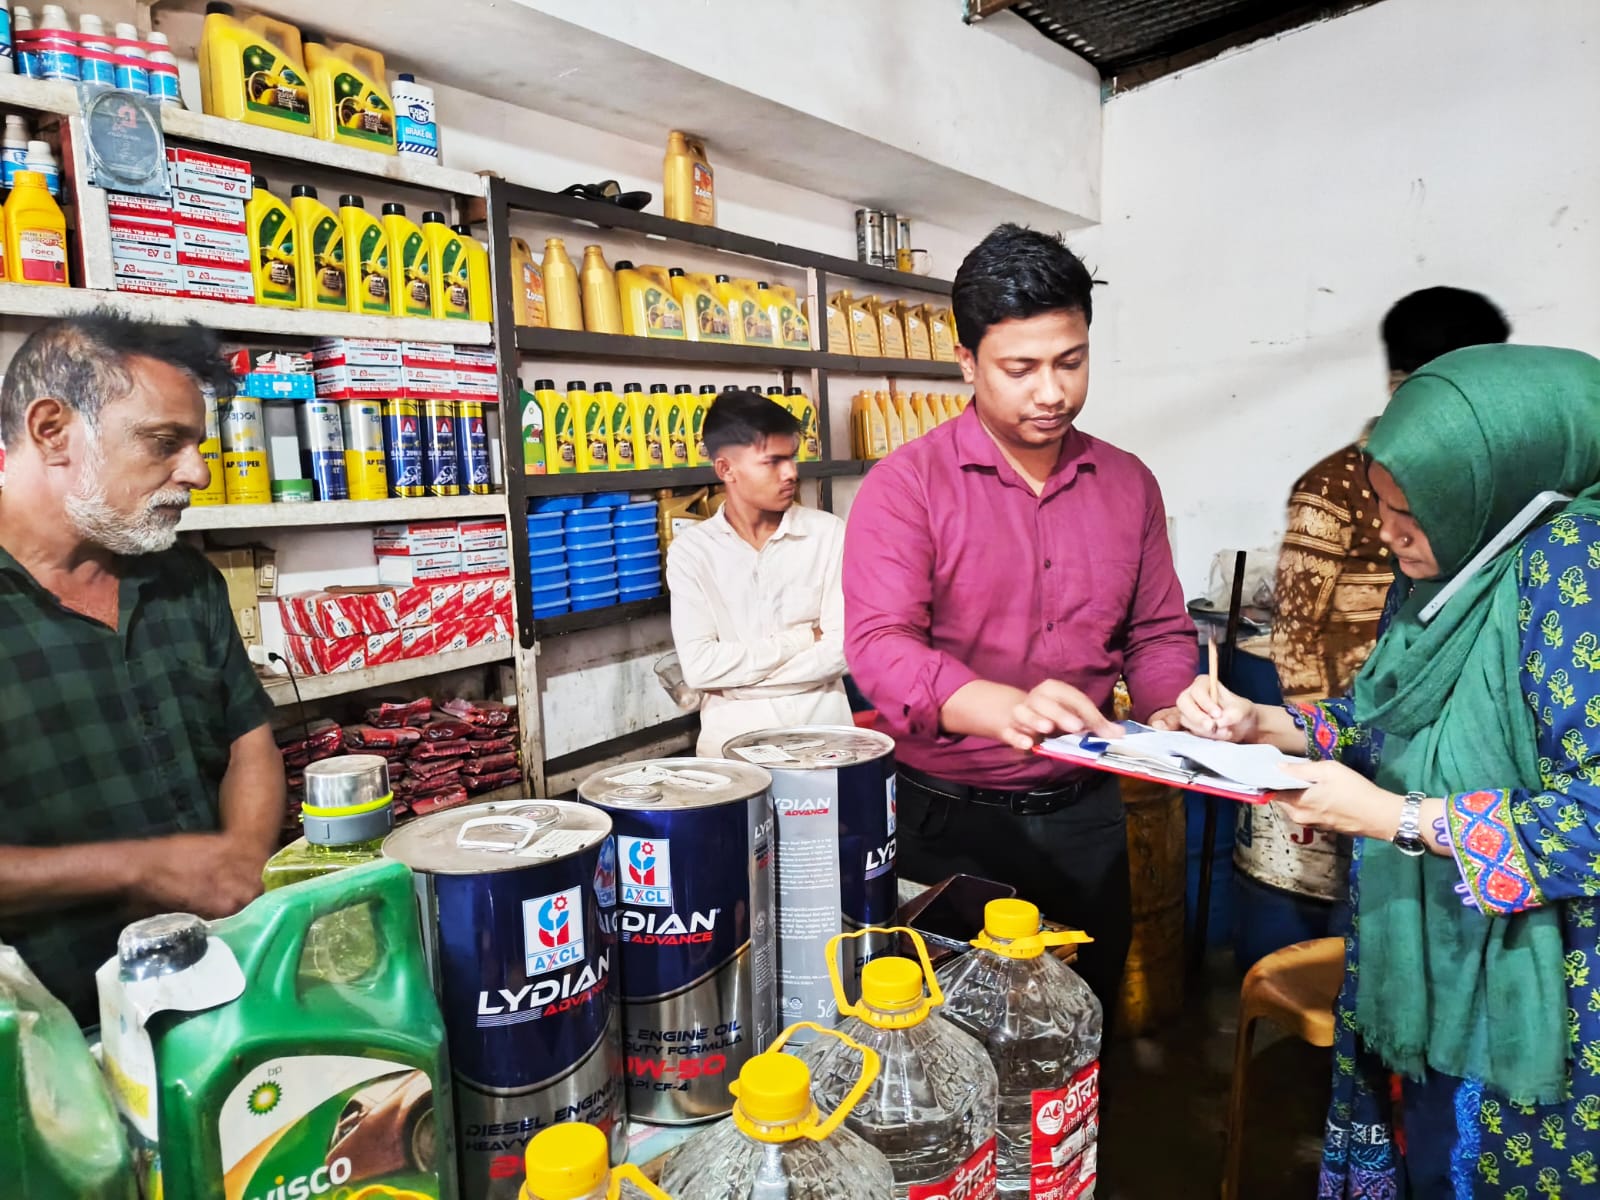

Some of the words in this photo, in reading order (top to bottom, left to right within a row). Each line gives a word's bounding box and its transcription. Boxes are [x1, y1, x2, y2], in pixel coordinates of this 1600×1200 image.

[226, 460, 235, 468] AP
[774, 797, 832, 810] DIAN
[784, 808, 829, 816] ADVANCE
[624, 887, 666, 904] AXCL
[618, 908, 716, 935] DIAN
[631, 931, 714, 946] ADVANCE
[534, 946, 580, 971] AXCL
[477, 947, 610, 1015] LYDIAN
[638, 1027, 709, 1042] ENGINE
[714, 1020, 742, 1036] OIL
[667, 1034, 743, 1055] FORMULA
[267, 1065, 282, 1077] bp
[653, 1080, 689, 1091] CF-4
[465, 1116, 547, 1137] DIESEL
